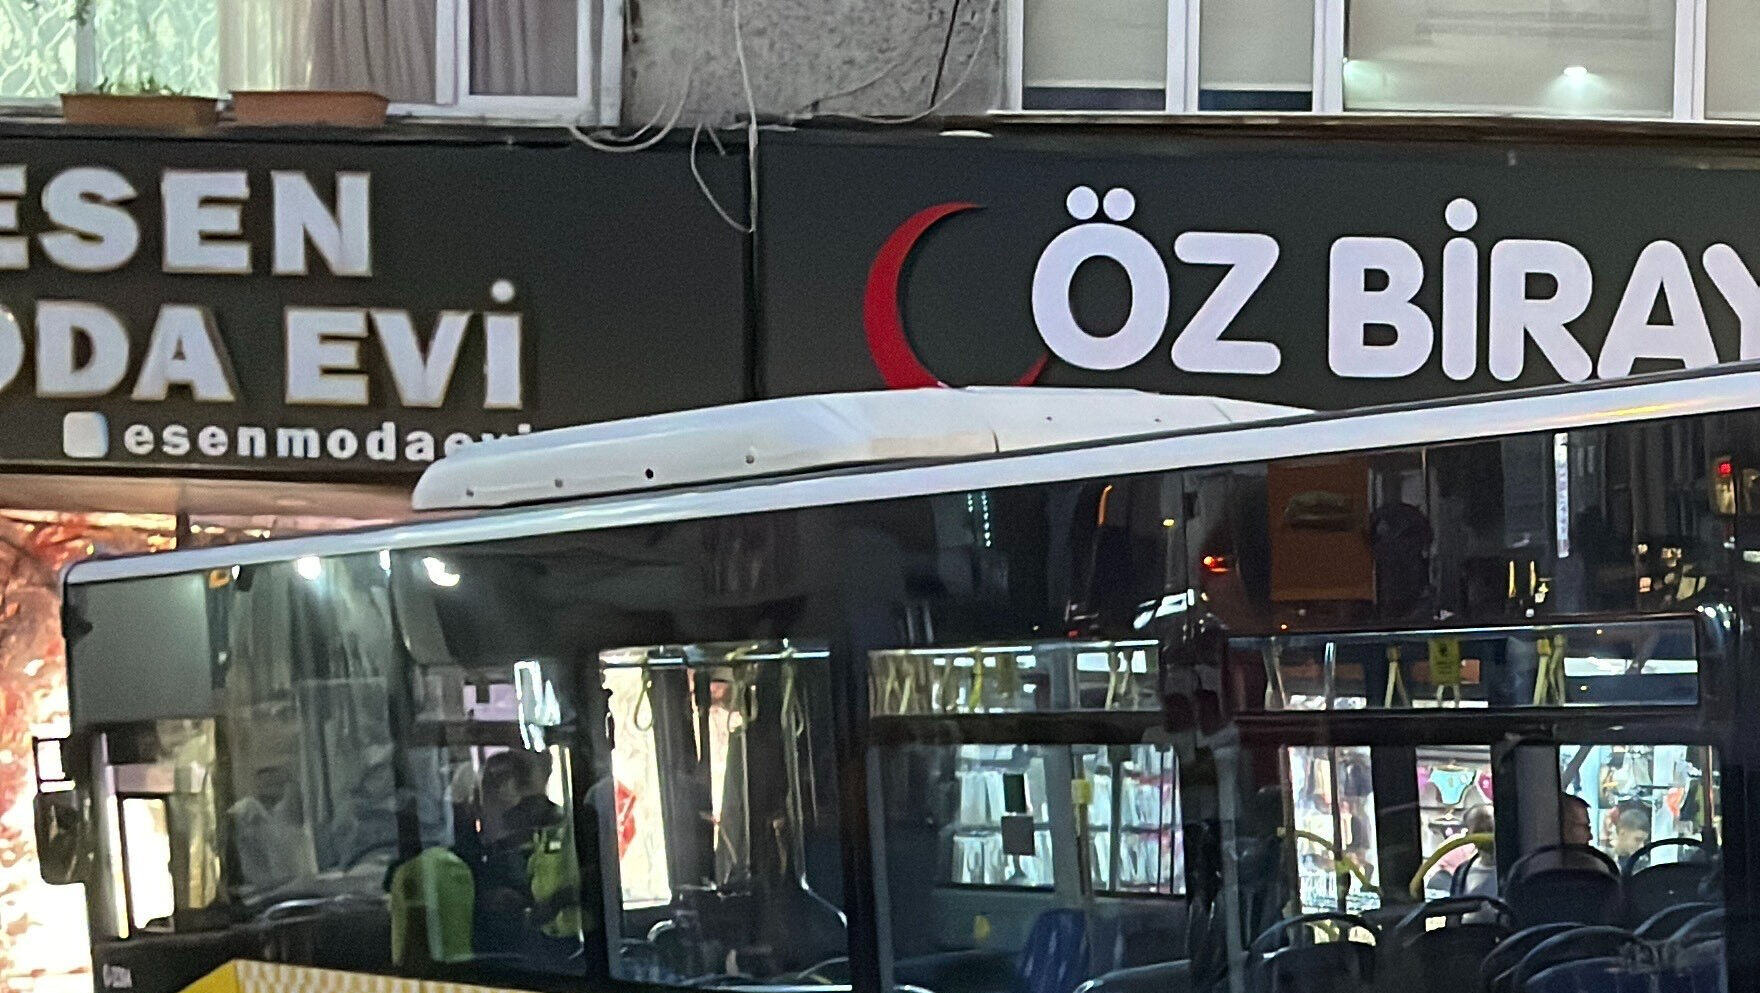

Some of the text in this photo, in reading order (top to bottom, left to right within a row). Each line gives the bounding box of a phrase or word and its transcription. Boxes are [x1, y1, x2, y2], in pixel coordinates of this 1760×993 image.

[0, 279, 523, 410] DA EVİ
[1031, 185, 1282, 375] ÖZ
